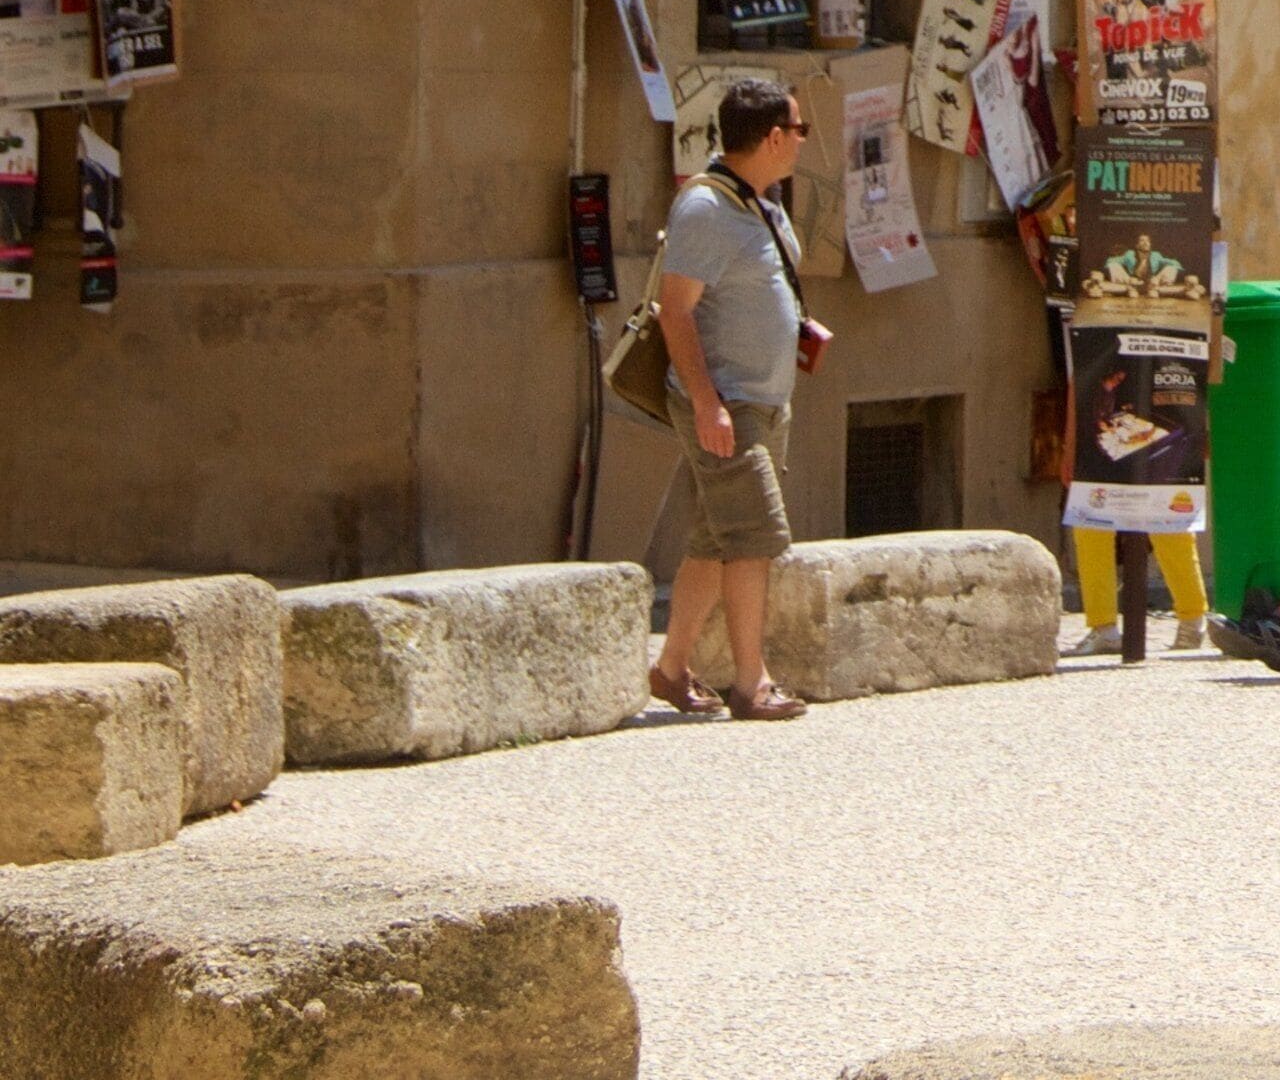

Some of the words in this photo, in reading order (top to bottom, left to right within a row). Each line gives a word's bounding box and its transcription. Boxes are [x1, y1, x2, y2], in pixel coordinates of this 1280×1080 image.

[1129, 108, 1147, 120] 90
[1168, 107, 1188, 120] 02
[1190, 106, 1210, 119] 03
[1087, 160, 1202, 193] PATINOIRE
[1153, 373, 1196, 386] BORJA
